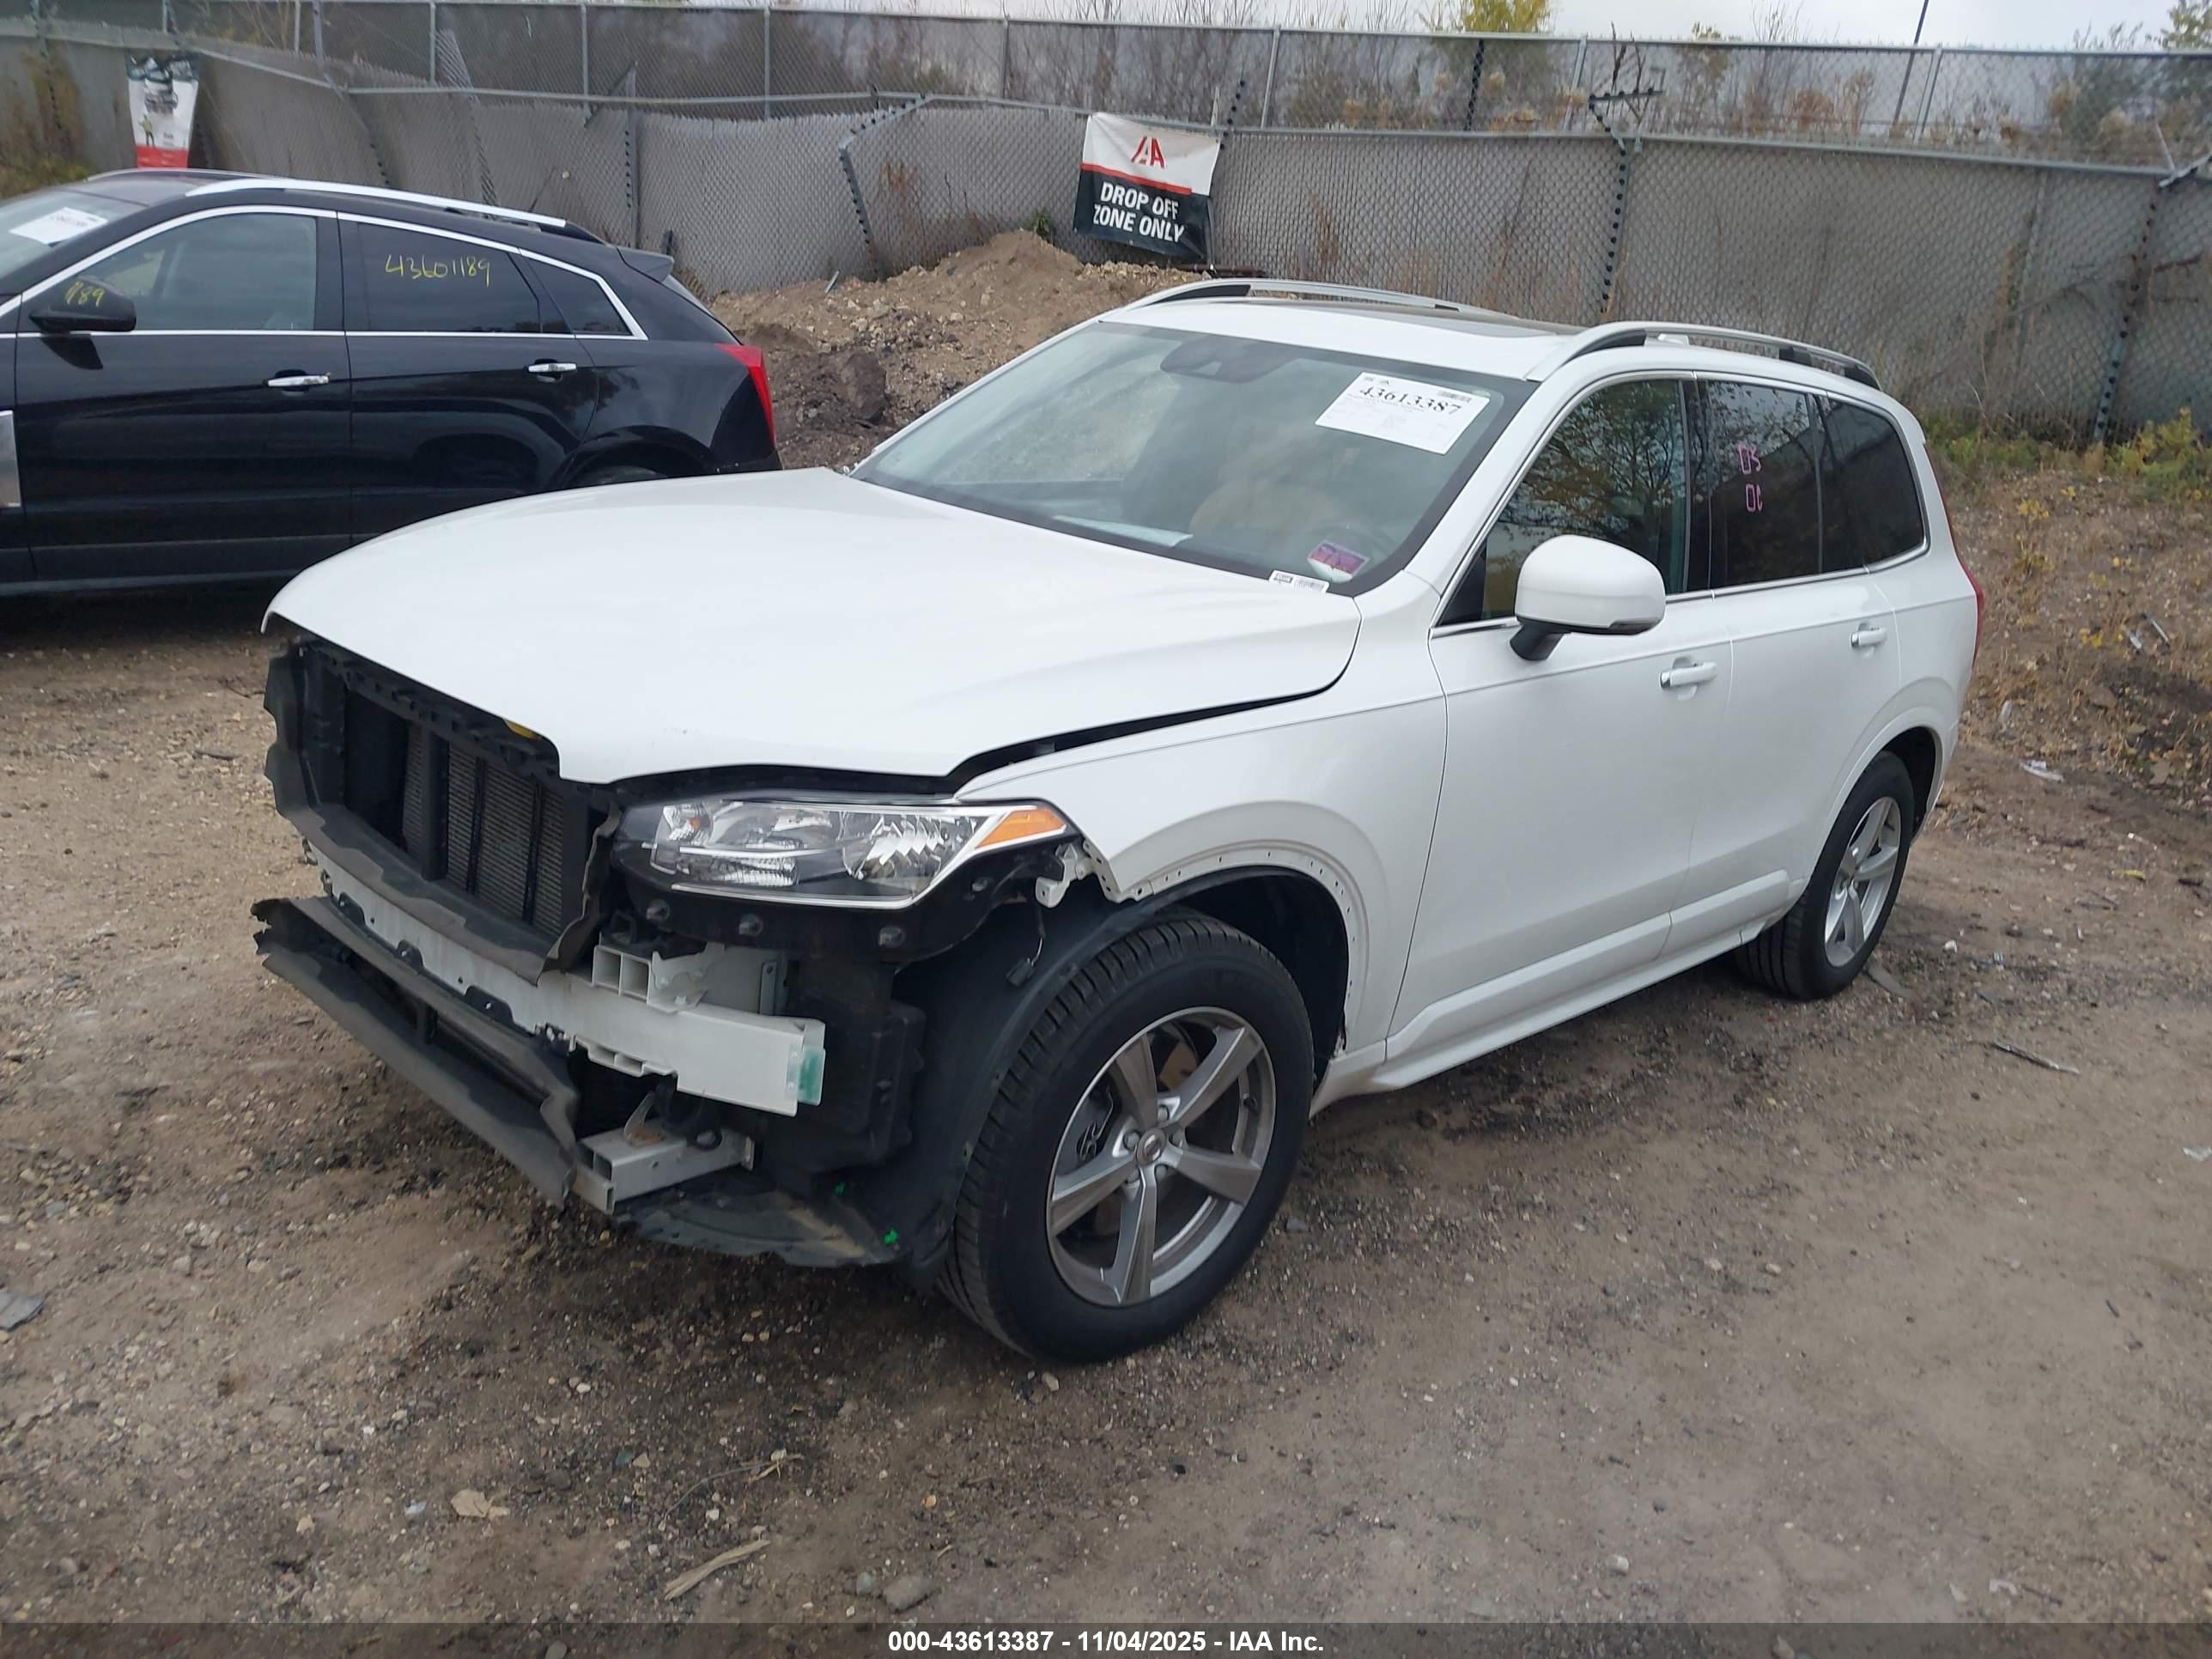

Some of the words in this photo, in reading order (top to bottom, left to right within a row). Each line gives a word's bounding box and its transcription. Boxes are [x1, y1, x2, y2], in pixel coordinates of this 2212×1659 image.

[1100, 181, 1150, 210] DROP
[1152, 196, 1179, 220] OFF
[1093, 204, 1136, 232] ZONE
[1139, 215, 1184, 243] ONLY
[386, 254, 490, 288] 43601189
[1360, 386, 1462, 416] 43613387
